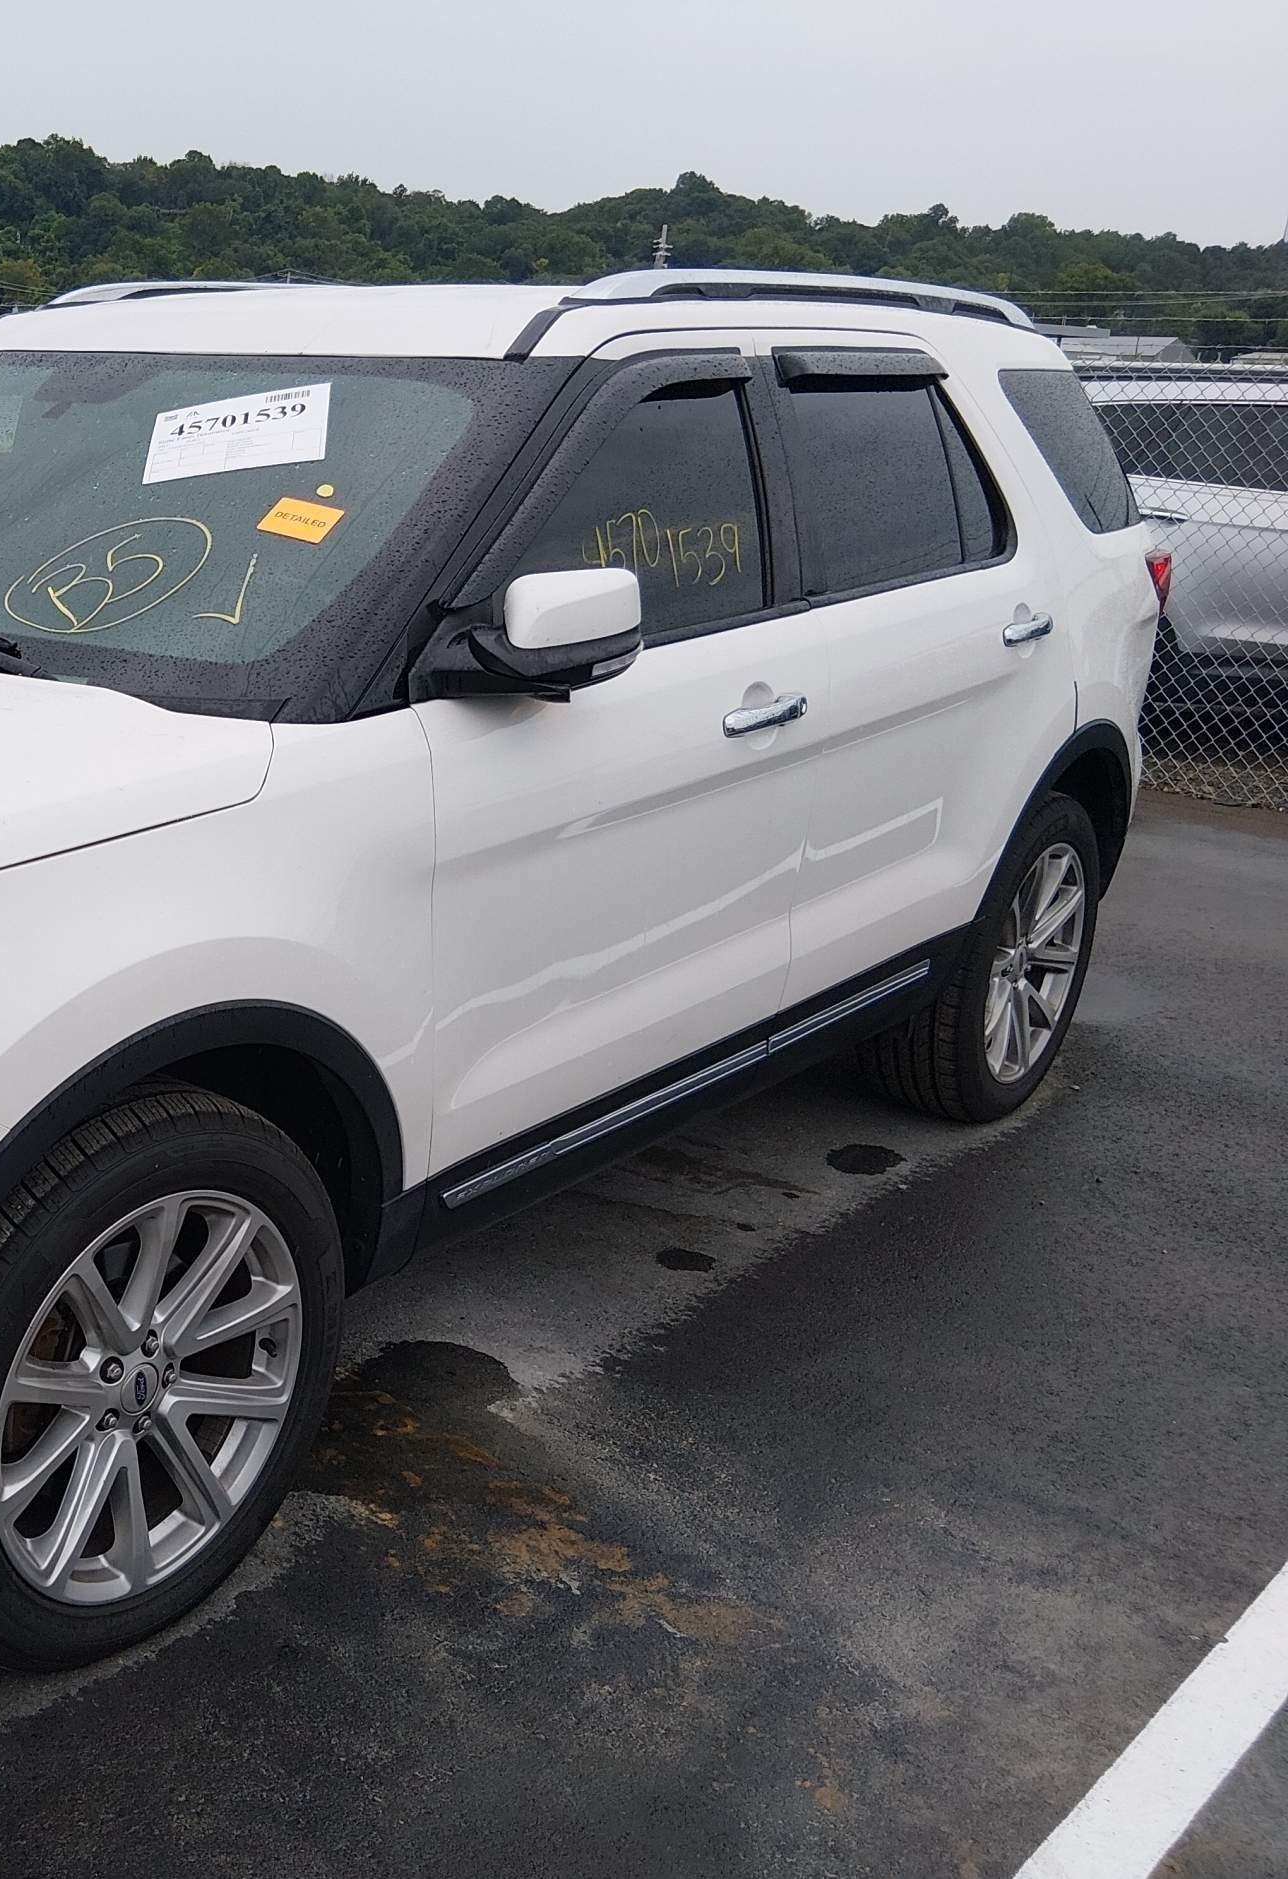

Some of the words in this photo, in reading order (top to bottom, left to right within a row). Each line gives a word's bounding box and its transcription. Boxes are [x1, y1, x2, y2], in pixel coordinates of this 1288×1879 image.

[170, 403, 307, 437] 45701539
[274, 511, 326, 528] DETAILED
[137, 1377, 146, 1400] Ford
